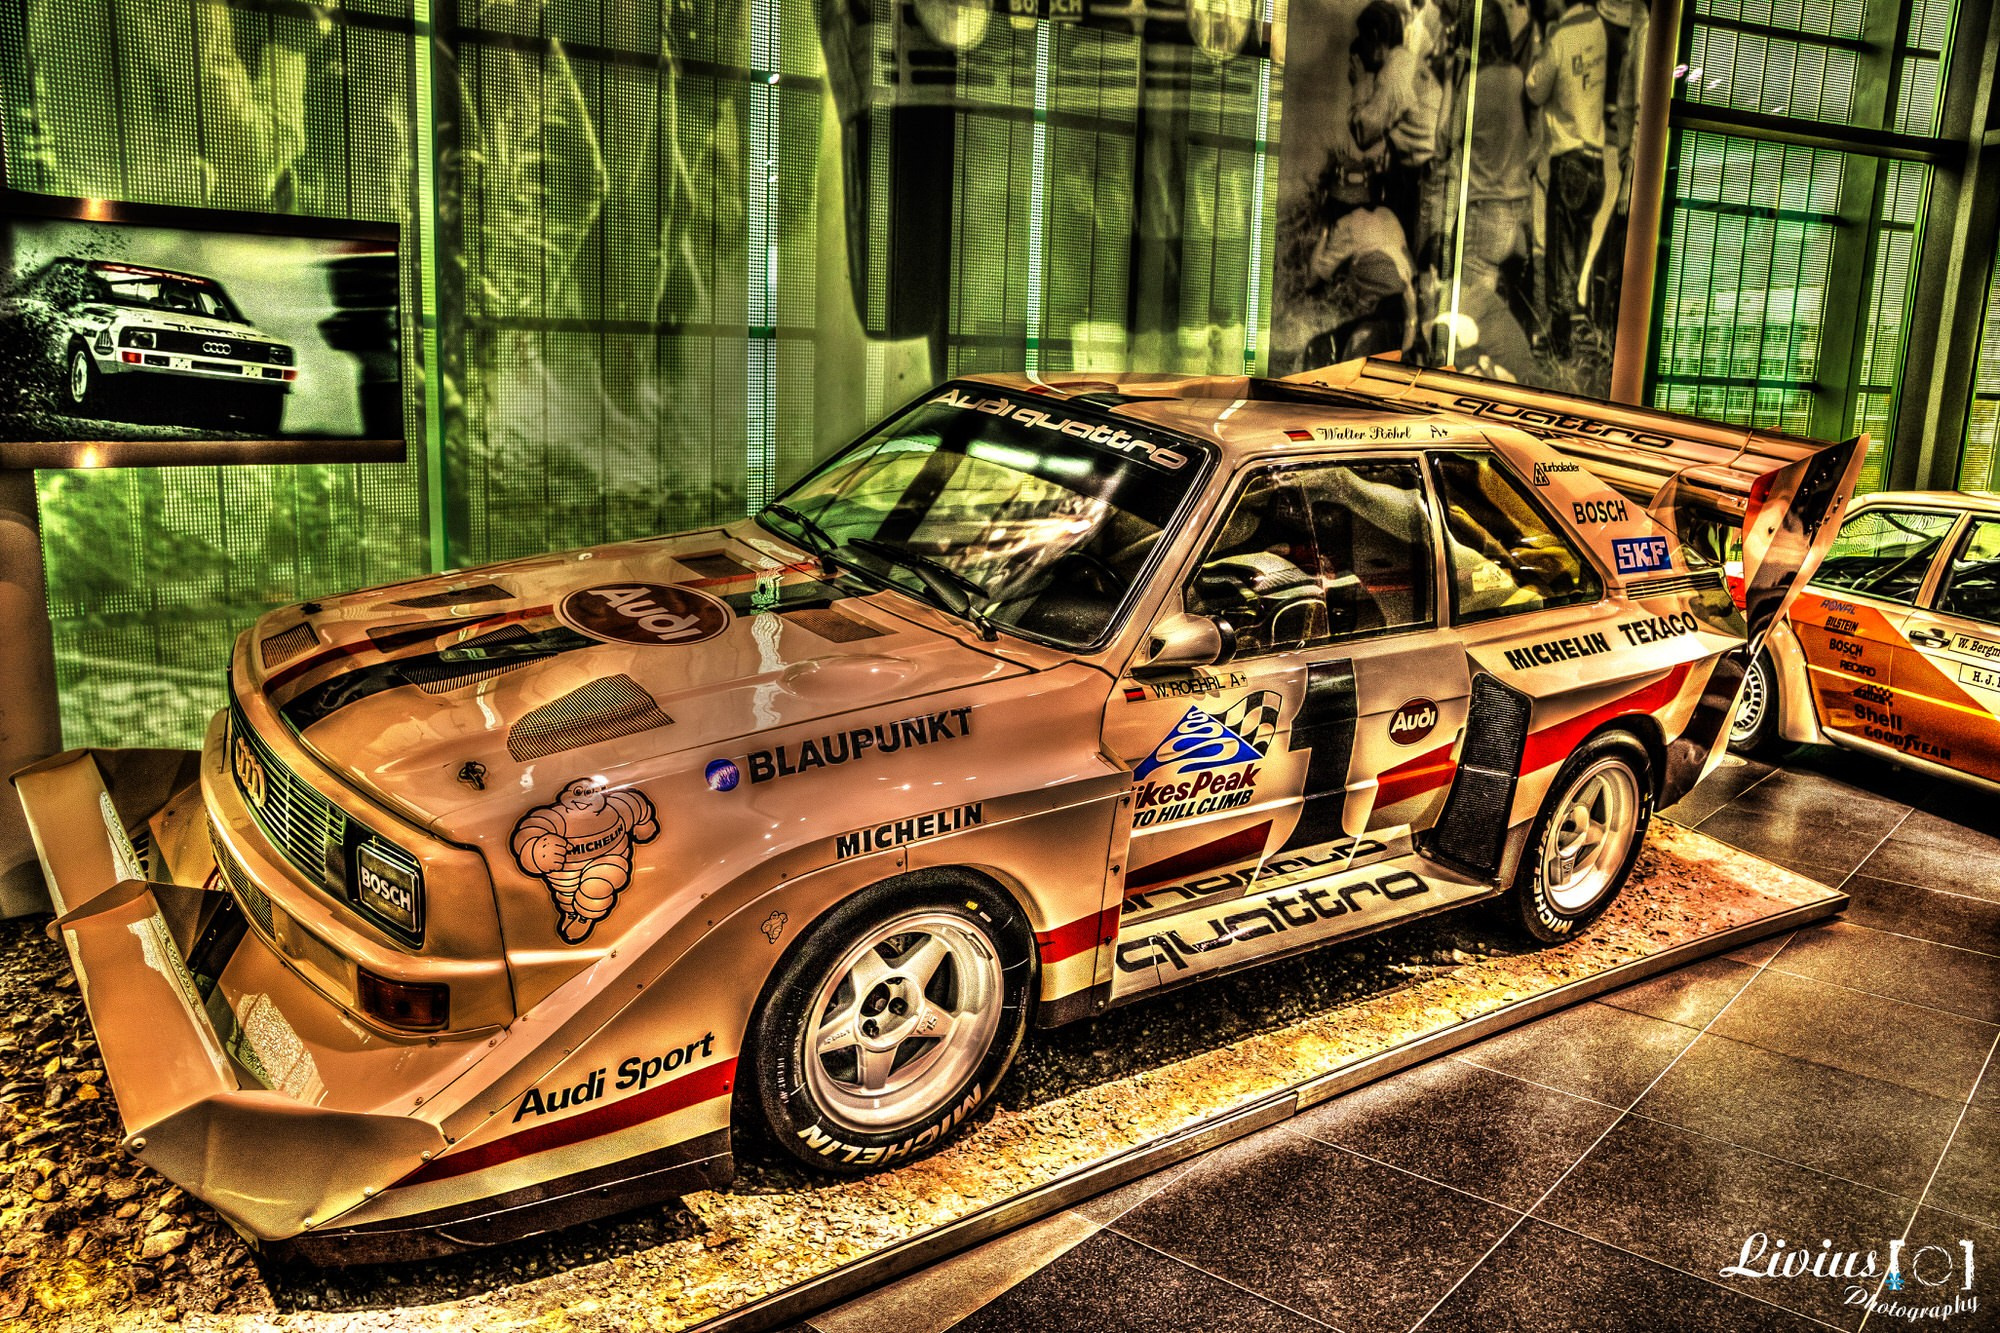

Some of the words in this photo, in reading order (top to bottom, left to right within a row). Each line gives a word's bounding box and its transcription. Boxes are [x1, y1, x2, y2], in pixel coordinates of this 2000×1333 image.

[928, 389, 1008, 417] Audi
[1011, 408, 1188, 470] quattro
[1316, 427, 1366, 441] Walter
[1369, 426, 1411, 440] Röhrl
[1453, 397, 1674, 448] quattro
[1541, 462, 1579, 472] Turbolader
[1572, 500, 1629, 524] BOSCH
[1617, 541, 1666, 569] SKF
[586, 587, 703, 641] Audi
[1825, 616, 1859, 632] BILSTEIN
[1504, 632, 1612, 670] MICHELIN
[1618, 611, 1699, 646] TEXACO
[1829, 638, 1864, 657] BOSCH
[1958, 637, 1970, 649] W.
[1839, 659, 1877, 677] RECARO
[1150, 684, 1169, 698] W.
[1171, 676, 1226, 696] ROEHRL
[1390, 707, 1436, 733] Audi
[1854, 704, 1902, 731] Shell
[747, 705, 973, 784] BLAUPUNKT
[1864, 726, 1951, 761] GOODYEAR
[1131, 781, 1191, 809] ikes
[1156, 801, 1197, 824] HILL
[1196, 789, 1254, 815] CLIMB
[566, 823, 623, 855] MICHELIN
[836, 802, 983, 860] MICHELIN
[361, 866, 411, 912] BOSCH
[1115, 869, 1430, 973] quattro
[512, 1067, 606, 1123] Audi
[616, 1031, 715, 1090] Sport
[796, 1083, 983, 1166] MICHELIN
